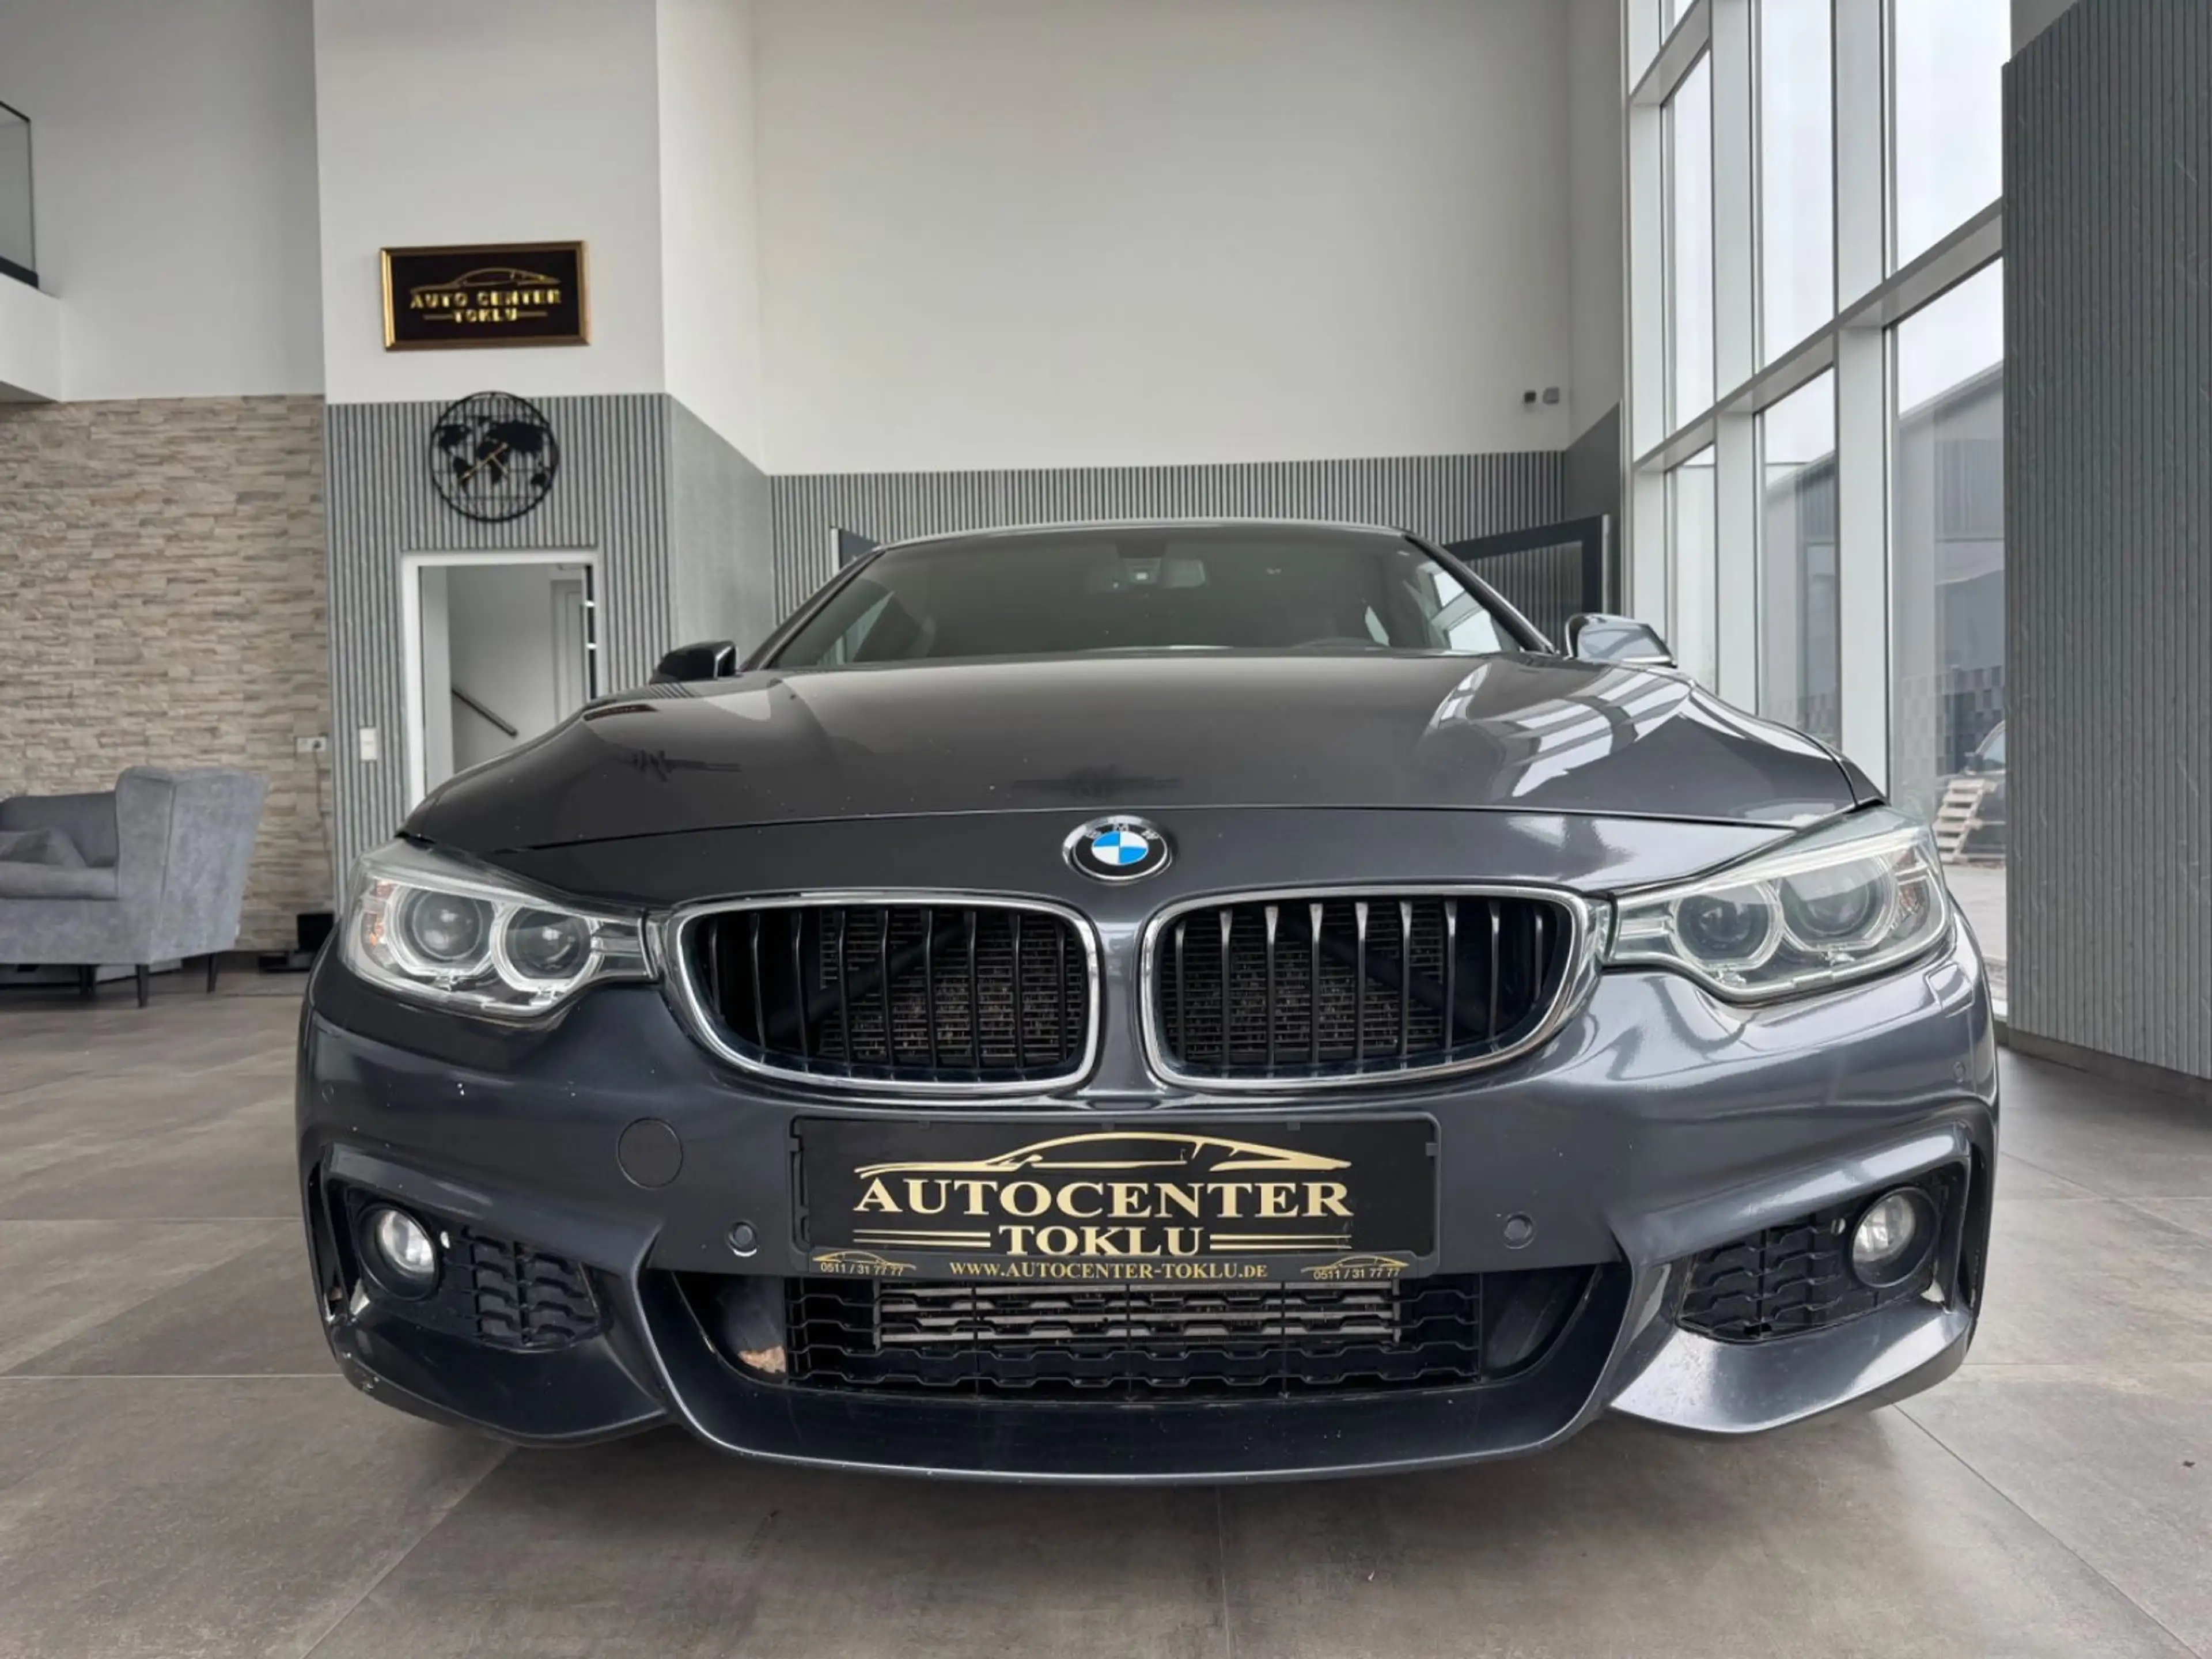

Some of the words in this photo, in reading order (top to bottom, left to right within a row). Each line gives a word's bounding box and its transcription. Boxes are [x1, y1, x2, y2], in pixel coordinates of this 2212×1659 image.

[410, 291, 468, 309] AUTO
[477, 289, 562, 306] CENTER
[453, 308, 517, 323] TOKLU
[853, 1178, 1353, 1218] AUTOCENTER
[999, 1226, 1201, 1256] TOKLU
[949, 1262, 1268, 1279] WWW.AUTOCENTER-TOKLU.DE
[1313, 1270, 1340, 1280] 0511
[1352, 1269, 1365, 1279] 31
[1370, 1268, 1383, 1278] 77
